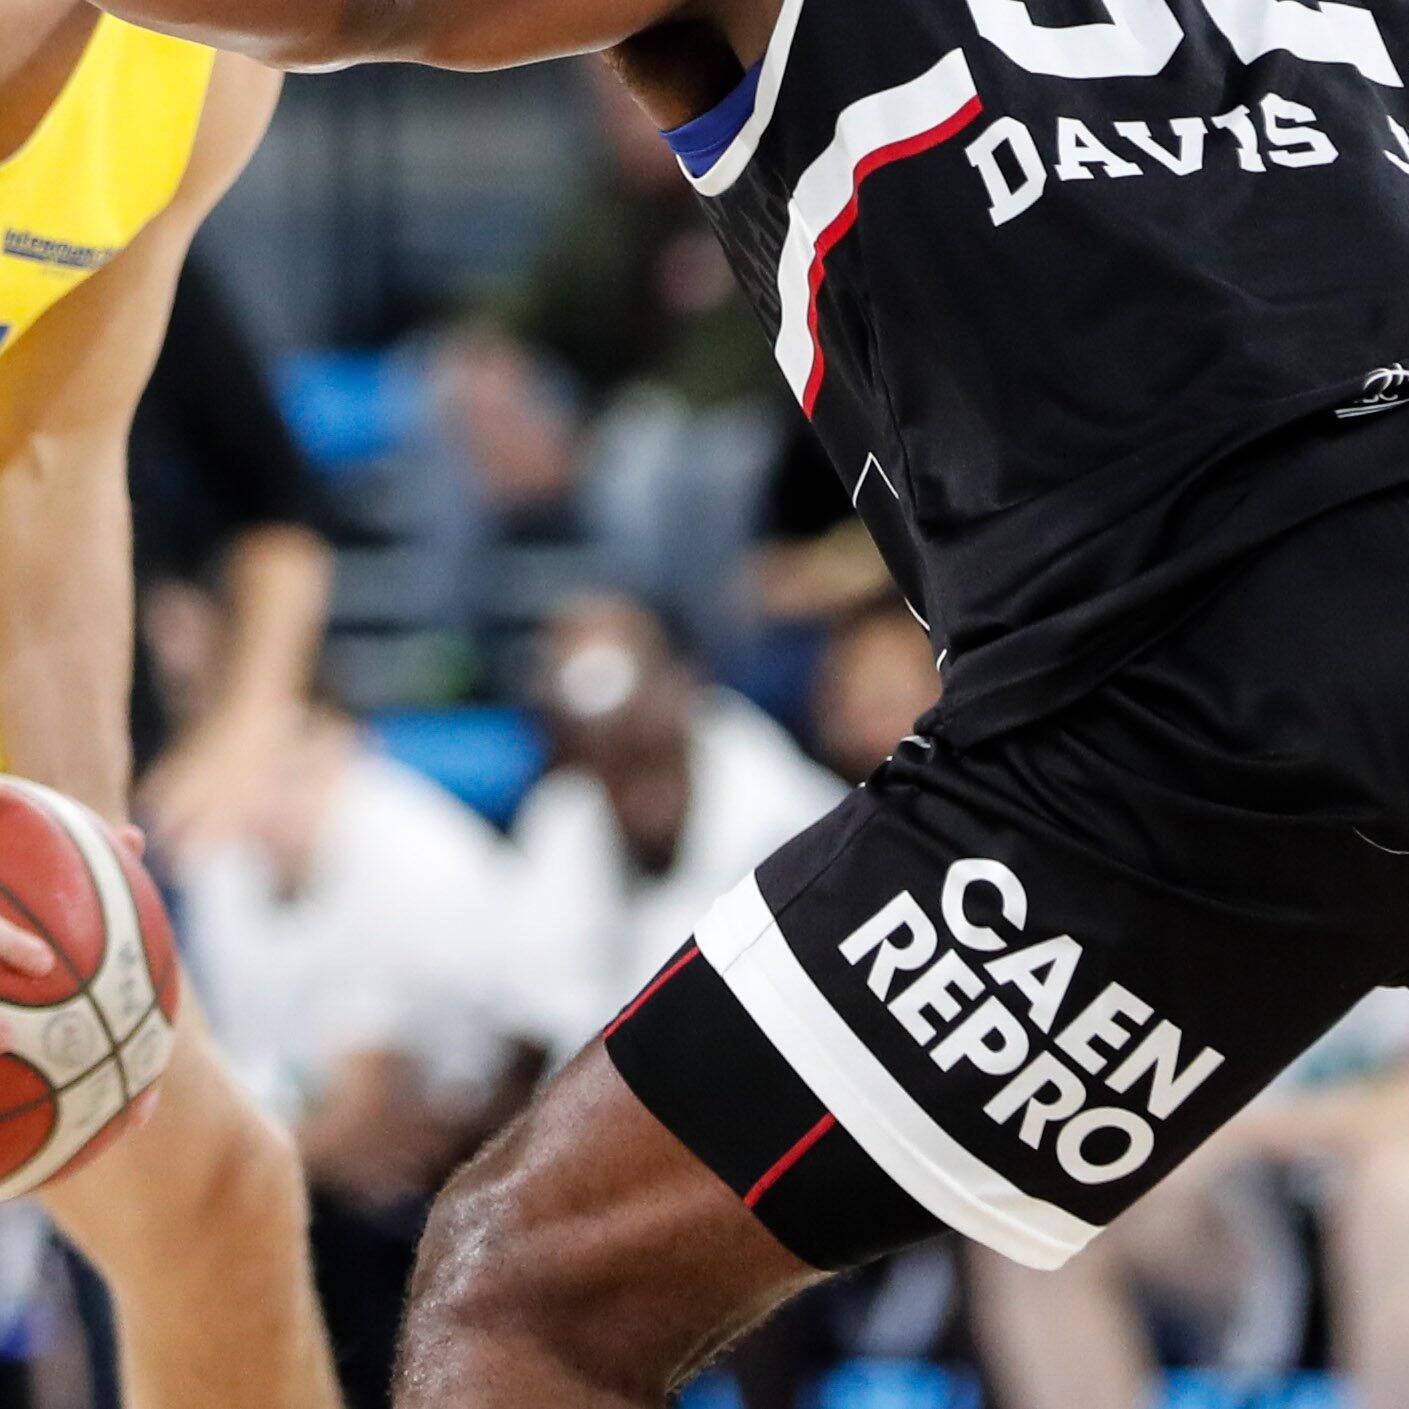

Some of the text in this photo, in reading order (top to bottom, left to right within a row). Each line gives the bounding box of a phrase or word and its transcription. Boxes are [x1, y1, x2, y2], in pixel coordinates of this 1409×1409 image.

[964, 92, 1340, 227] DAVIS
[837, 889, 1155, 1185] REPRO
[941, 857, 1226, 1122] CAEN
